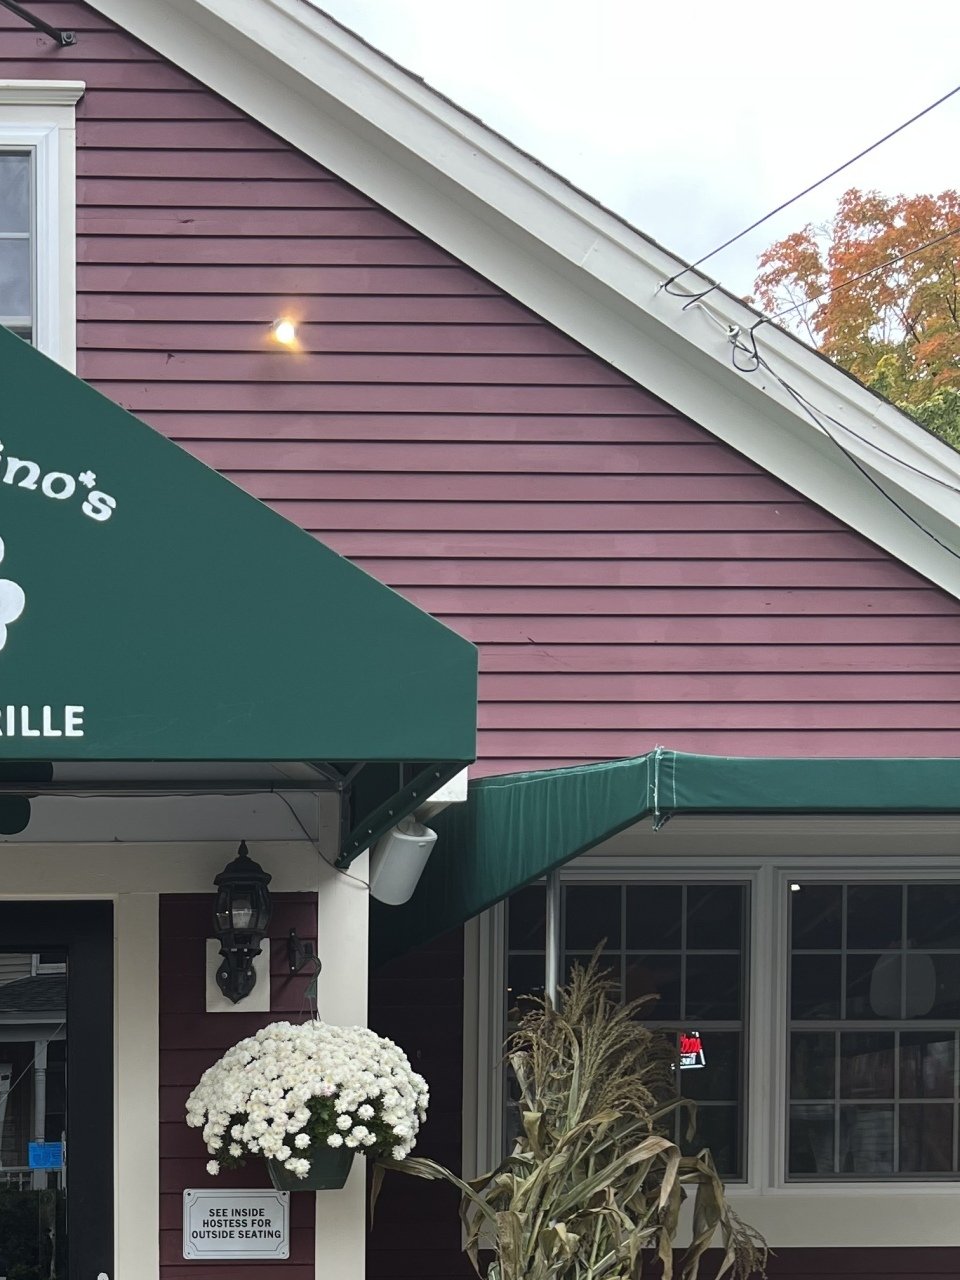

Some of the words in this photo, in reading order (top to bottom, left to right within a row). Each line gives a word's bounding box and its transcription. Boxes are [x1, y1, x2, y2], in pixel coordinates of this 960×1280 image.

[209, 1208, 228, 1217] SEE
[231, 1208, 265, 1217] INSIDE
[203, 1219, 248, 1227] HOSTESS
[251, 1219, 271, 1227] FOR
[192, 1230, 235, 1239] OUTSIDE
[238, 1230, 281, 1239] SEATING
